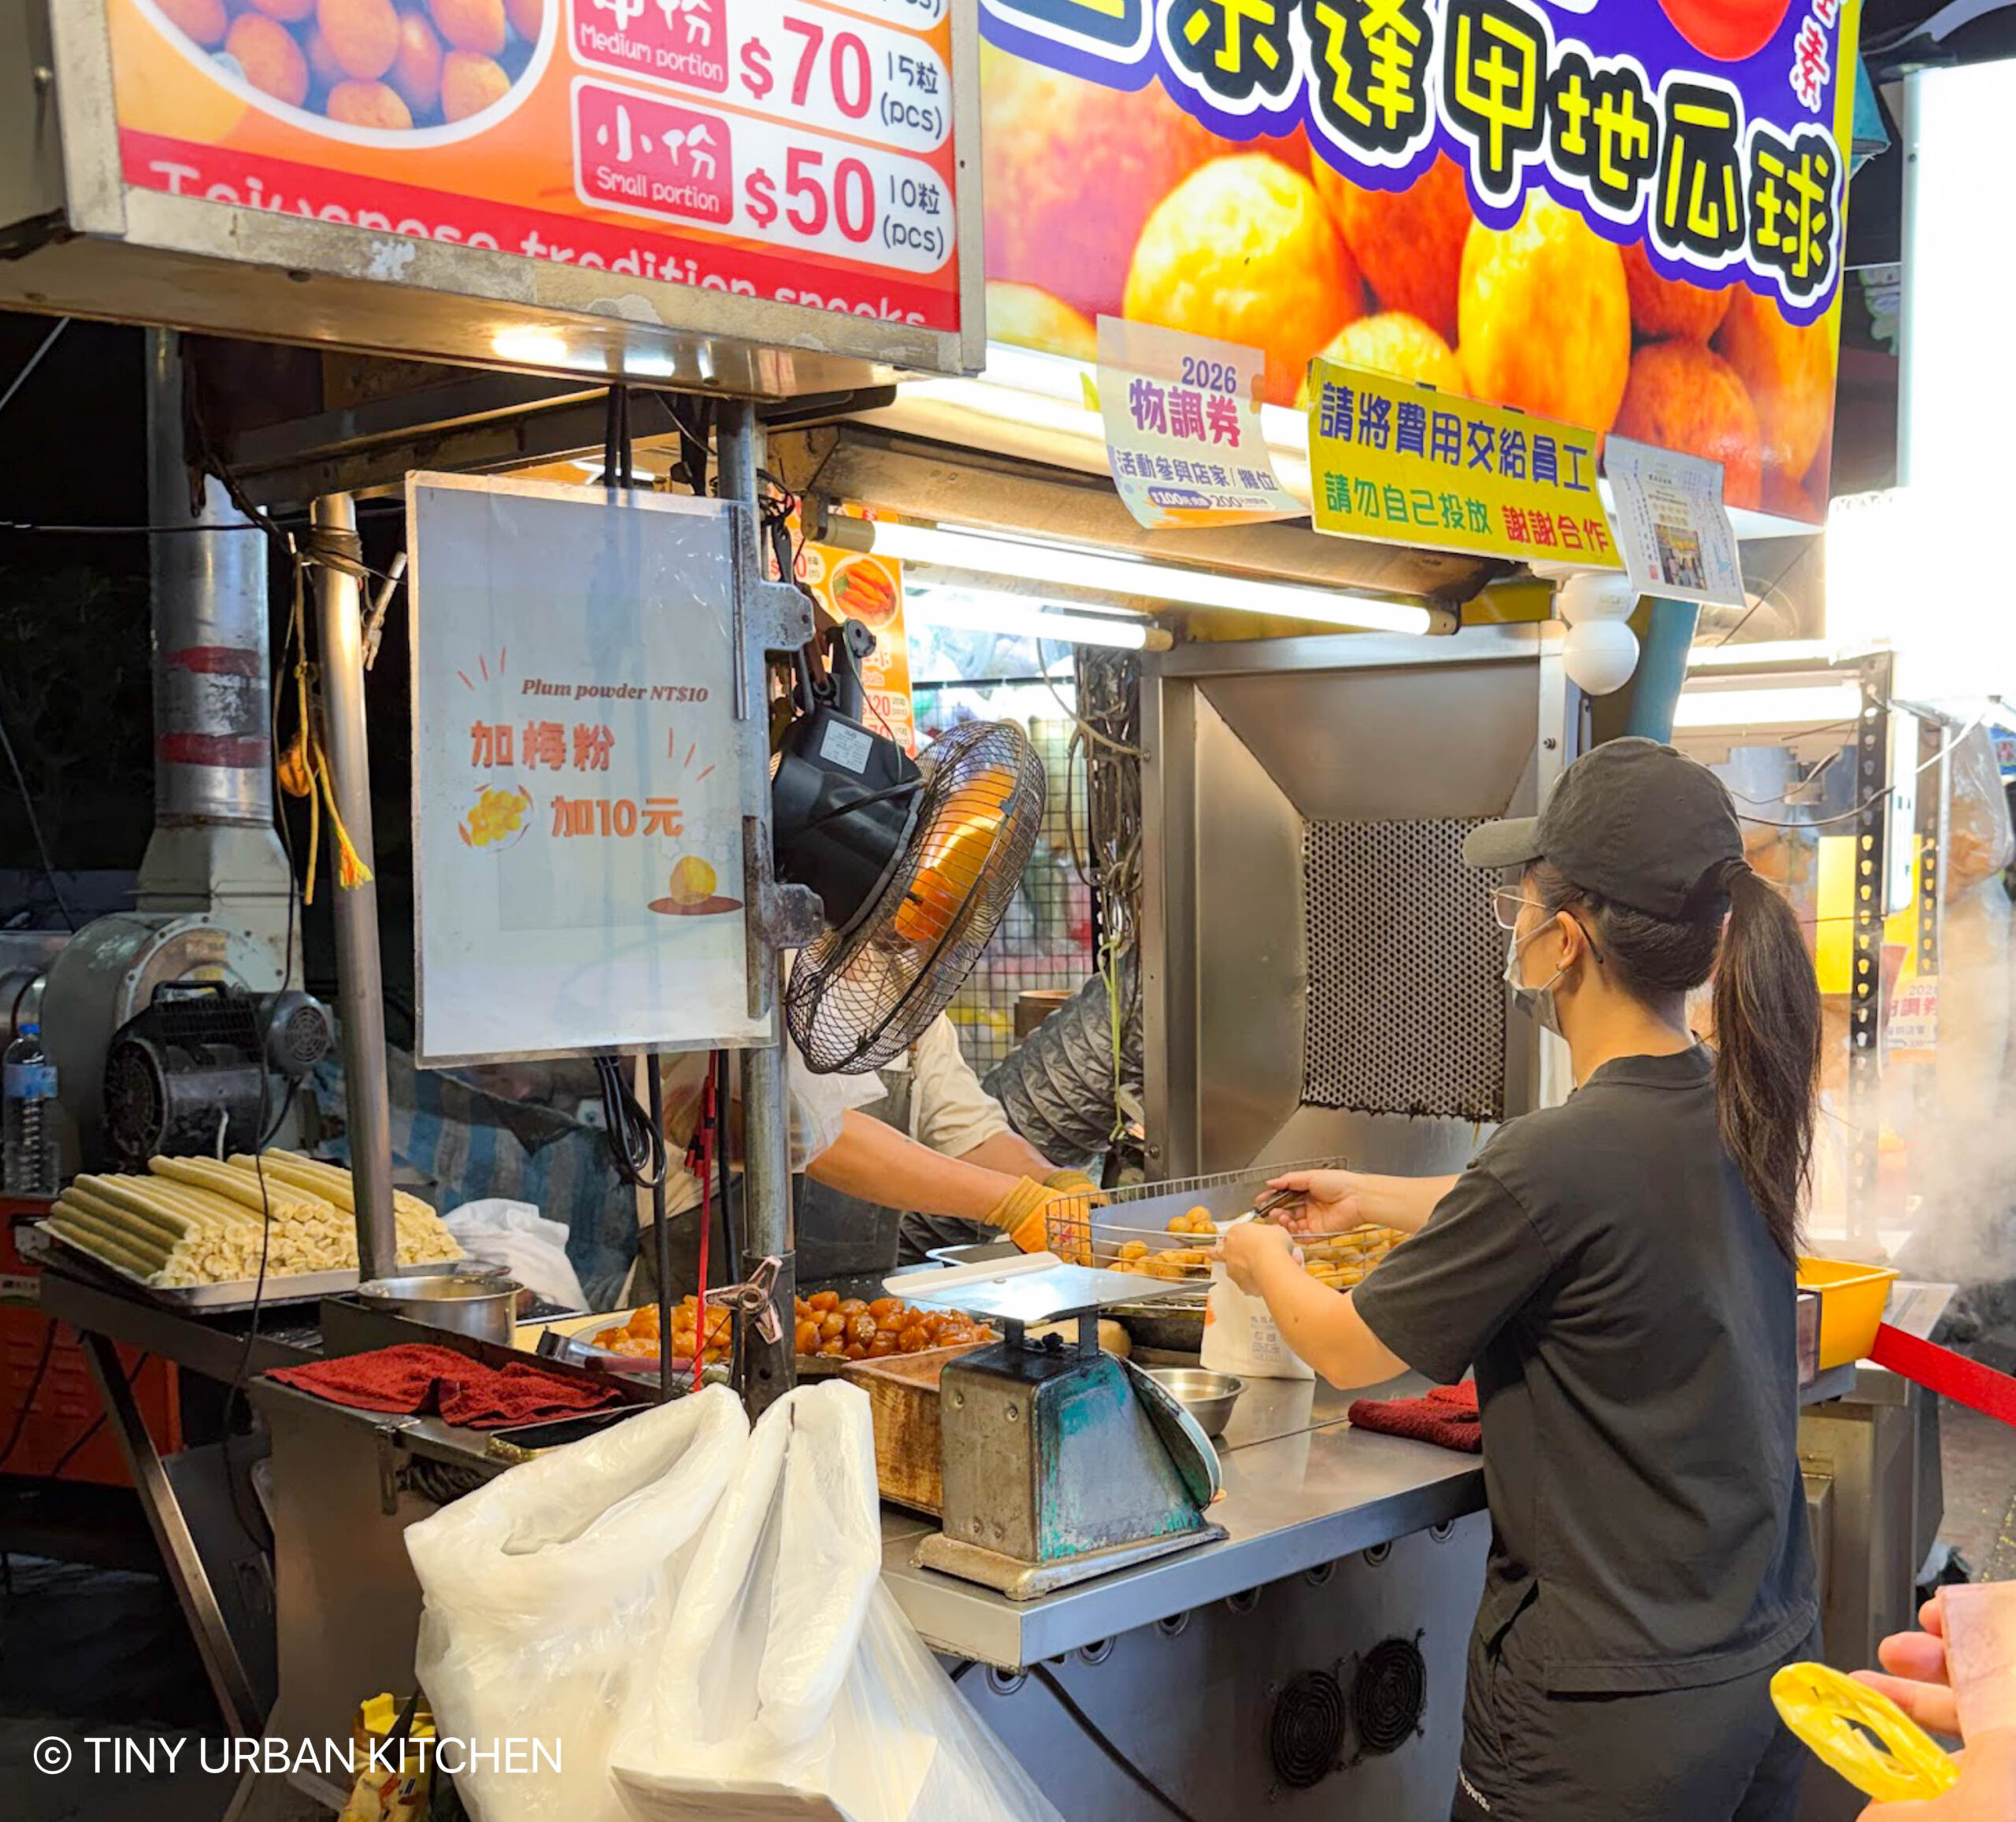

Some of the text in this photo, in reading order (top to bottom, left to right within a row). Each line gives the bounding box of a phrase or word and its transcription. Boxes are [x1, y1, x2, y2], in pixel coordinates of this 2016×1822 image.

[580, 22, 724, 82] Medium portion
[740, 15, 873, 120] $70
[887, 51, 939, 95] 15粒
[880, 92, 943, 140] (pcs)
[596, 104, 717, 180] 小份
[596, 165, 720, 213] Small portion
[744, 146, 876, 243] $50
[888, 174, 941, 215] 10粒
[882, 214, 945, 260] (pcs)
[1181, 356, 1237, 394] 2026
[1129, 378, 1241, 448] 物調券
[1319, 381, 1592, 494] 請將費用交給員工
[1324, 471, 1493, 535] 請勿自己投放
[1501, 505, 1610, 553] 謝謝合作
[521, 679, 709, 702] Plum powder NT$10
[470, 720, 616, 772] 加梅粉
[550, 794, 684, 838] 加10元
